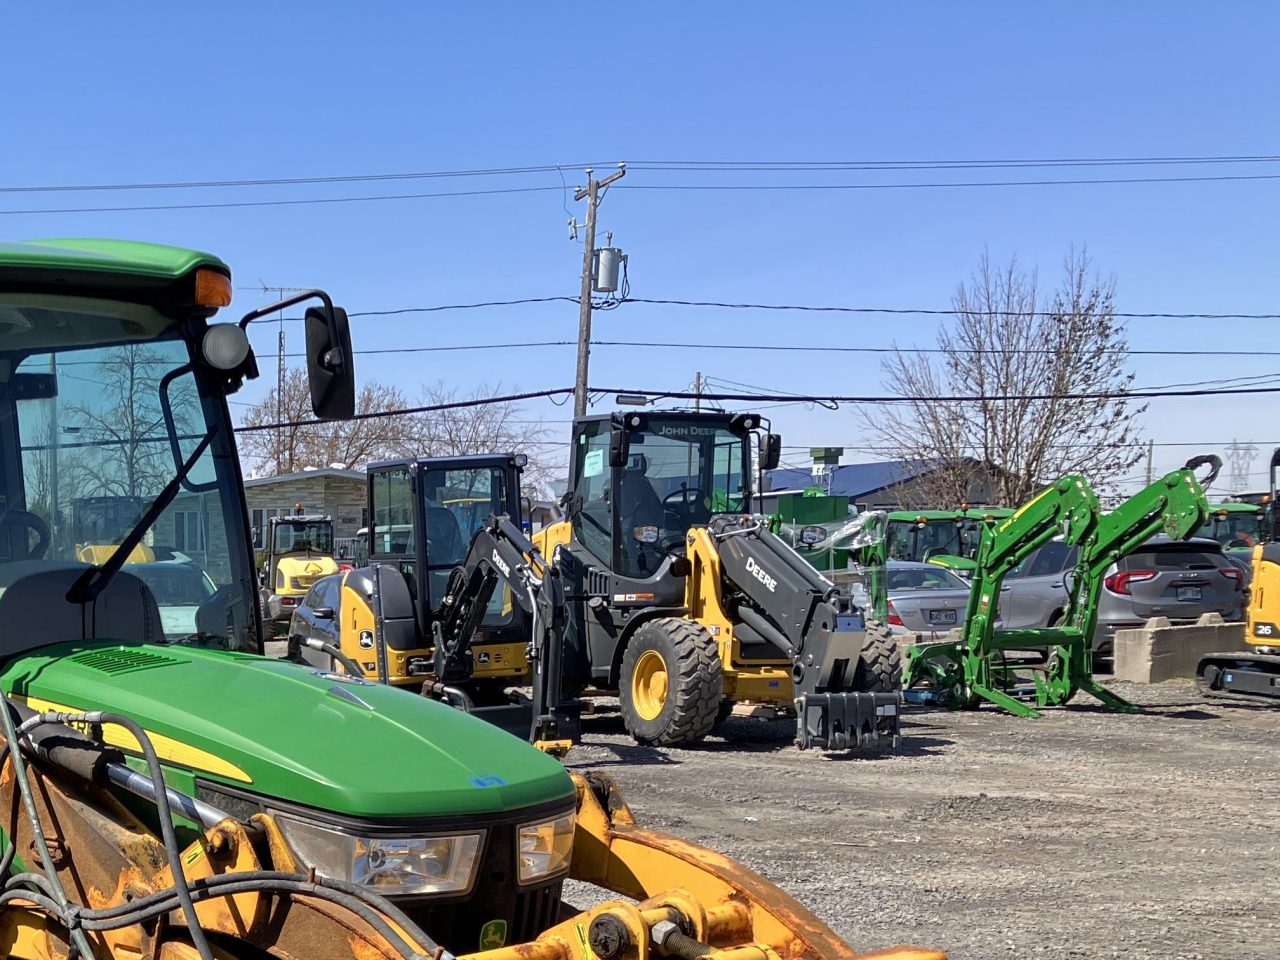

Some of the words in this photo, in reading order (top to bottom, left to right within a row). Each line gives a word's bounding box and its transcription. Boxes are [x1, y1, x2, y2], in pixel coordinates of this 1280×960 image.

[658, 425, 689, 436] JOHN
[491, 548, 511, 579] DEERE
[745, 556, 778, 593] DEERE
[1256, 625, 1272, 635] 26
